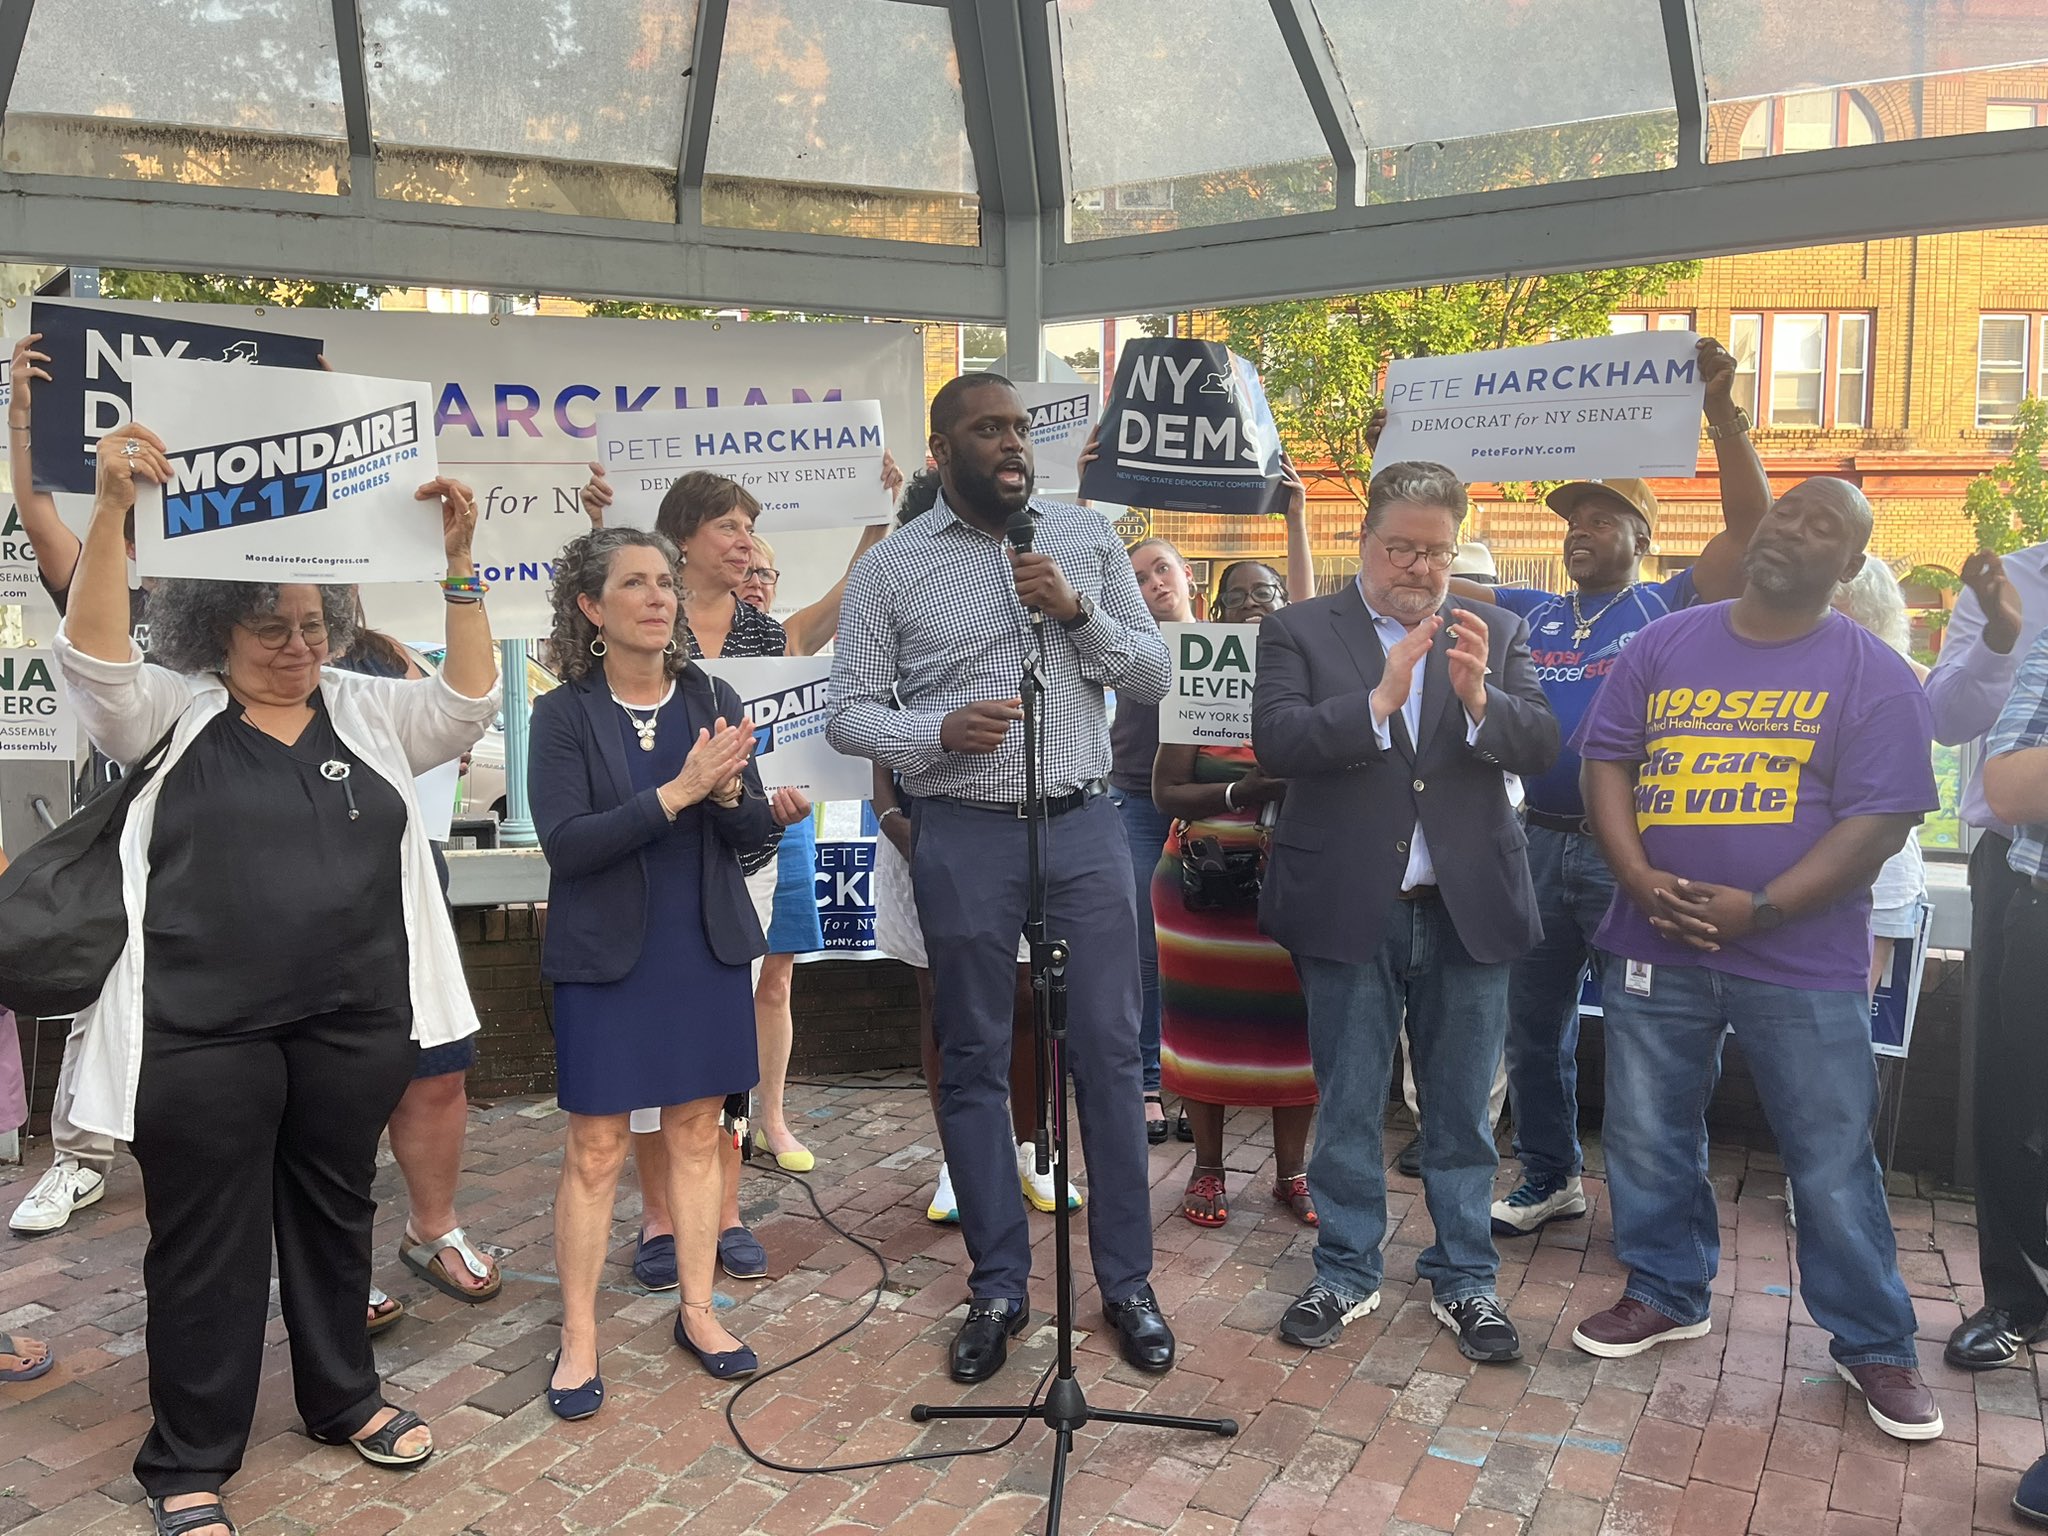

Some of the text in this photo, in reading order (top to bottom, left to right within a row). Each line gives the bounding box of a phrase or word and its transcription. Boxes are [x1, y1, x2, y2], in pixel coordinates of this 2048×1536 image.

[1126, 355, 1203, 404] NY
[1391, 359, 1695, 404] PETE HARCKHAM
[1029, 396, 1087, 428] AIRE
[1073, 418, 1088, 427] FOR
[1411, 406, 1653, 432] DEMOCRAT for NY SENATE
[608, 425, 881, 461] PETE HARCKHAM
[1118, 409, 1262, 463] DEMS
[166, 406, 415, 496] MONDAIRE
[331, 446, 419, 484] DEMOCRAT FOR
[1471, 445, 1576, 457] PeteForNY.com
[331, 471, 391, 500] CONGRESS
[742, 472, 762, 488] for
[767, 471, 790, 484] NY
[795, 467, 857, 482] SENATE
[1116, 471, 1267, 489] NEW YORK STATE DEMOCRATIC COMMITTEE
[166, 472, 324, 535] NY-17
[485, 486, 538, 520] for
[245, 554, 370, 566] MondaireForCongress.com
[1180, 633, 1258, 673] DA
[1179, 710, 1206, 720] NEW
[1209, 711, 1239, 723] YORK
[1669, 716, 1733, 731] Healthcare
[1738, 720, 1789, 732] Workers
[1793, 720, 1821, 734] East
[1692, 751, 1797, 775] care
[1685, 782, 1787, 814] vote
[823, 918, 850, 932] for
[822, 938, 875, 947] orNY.com
